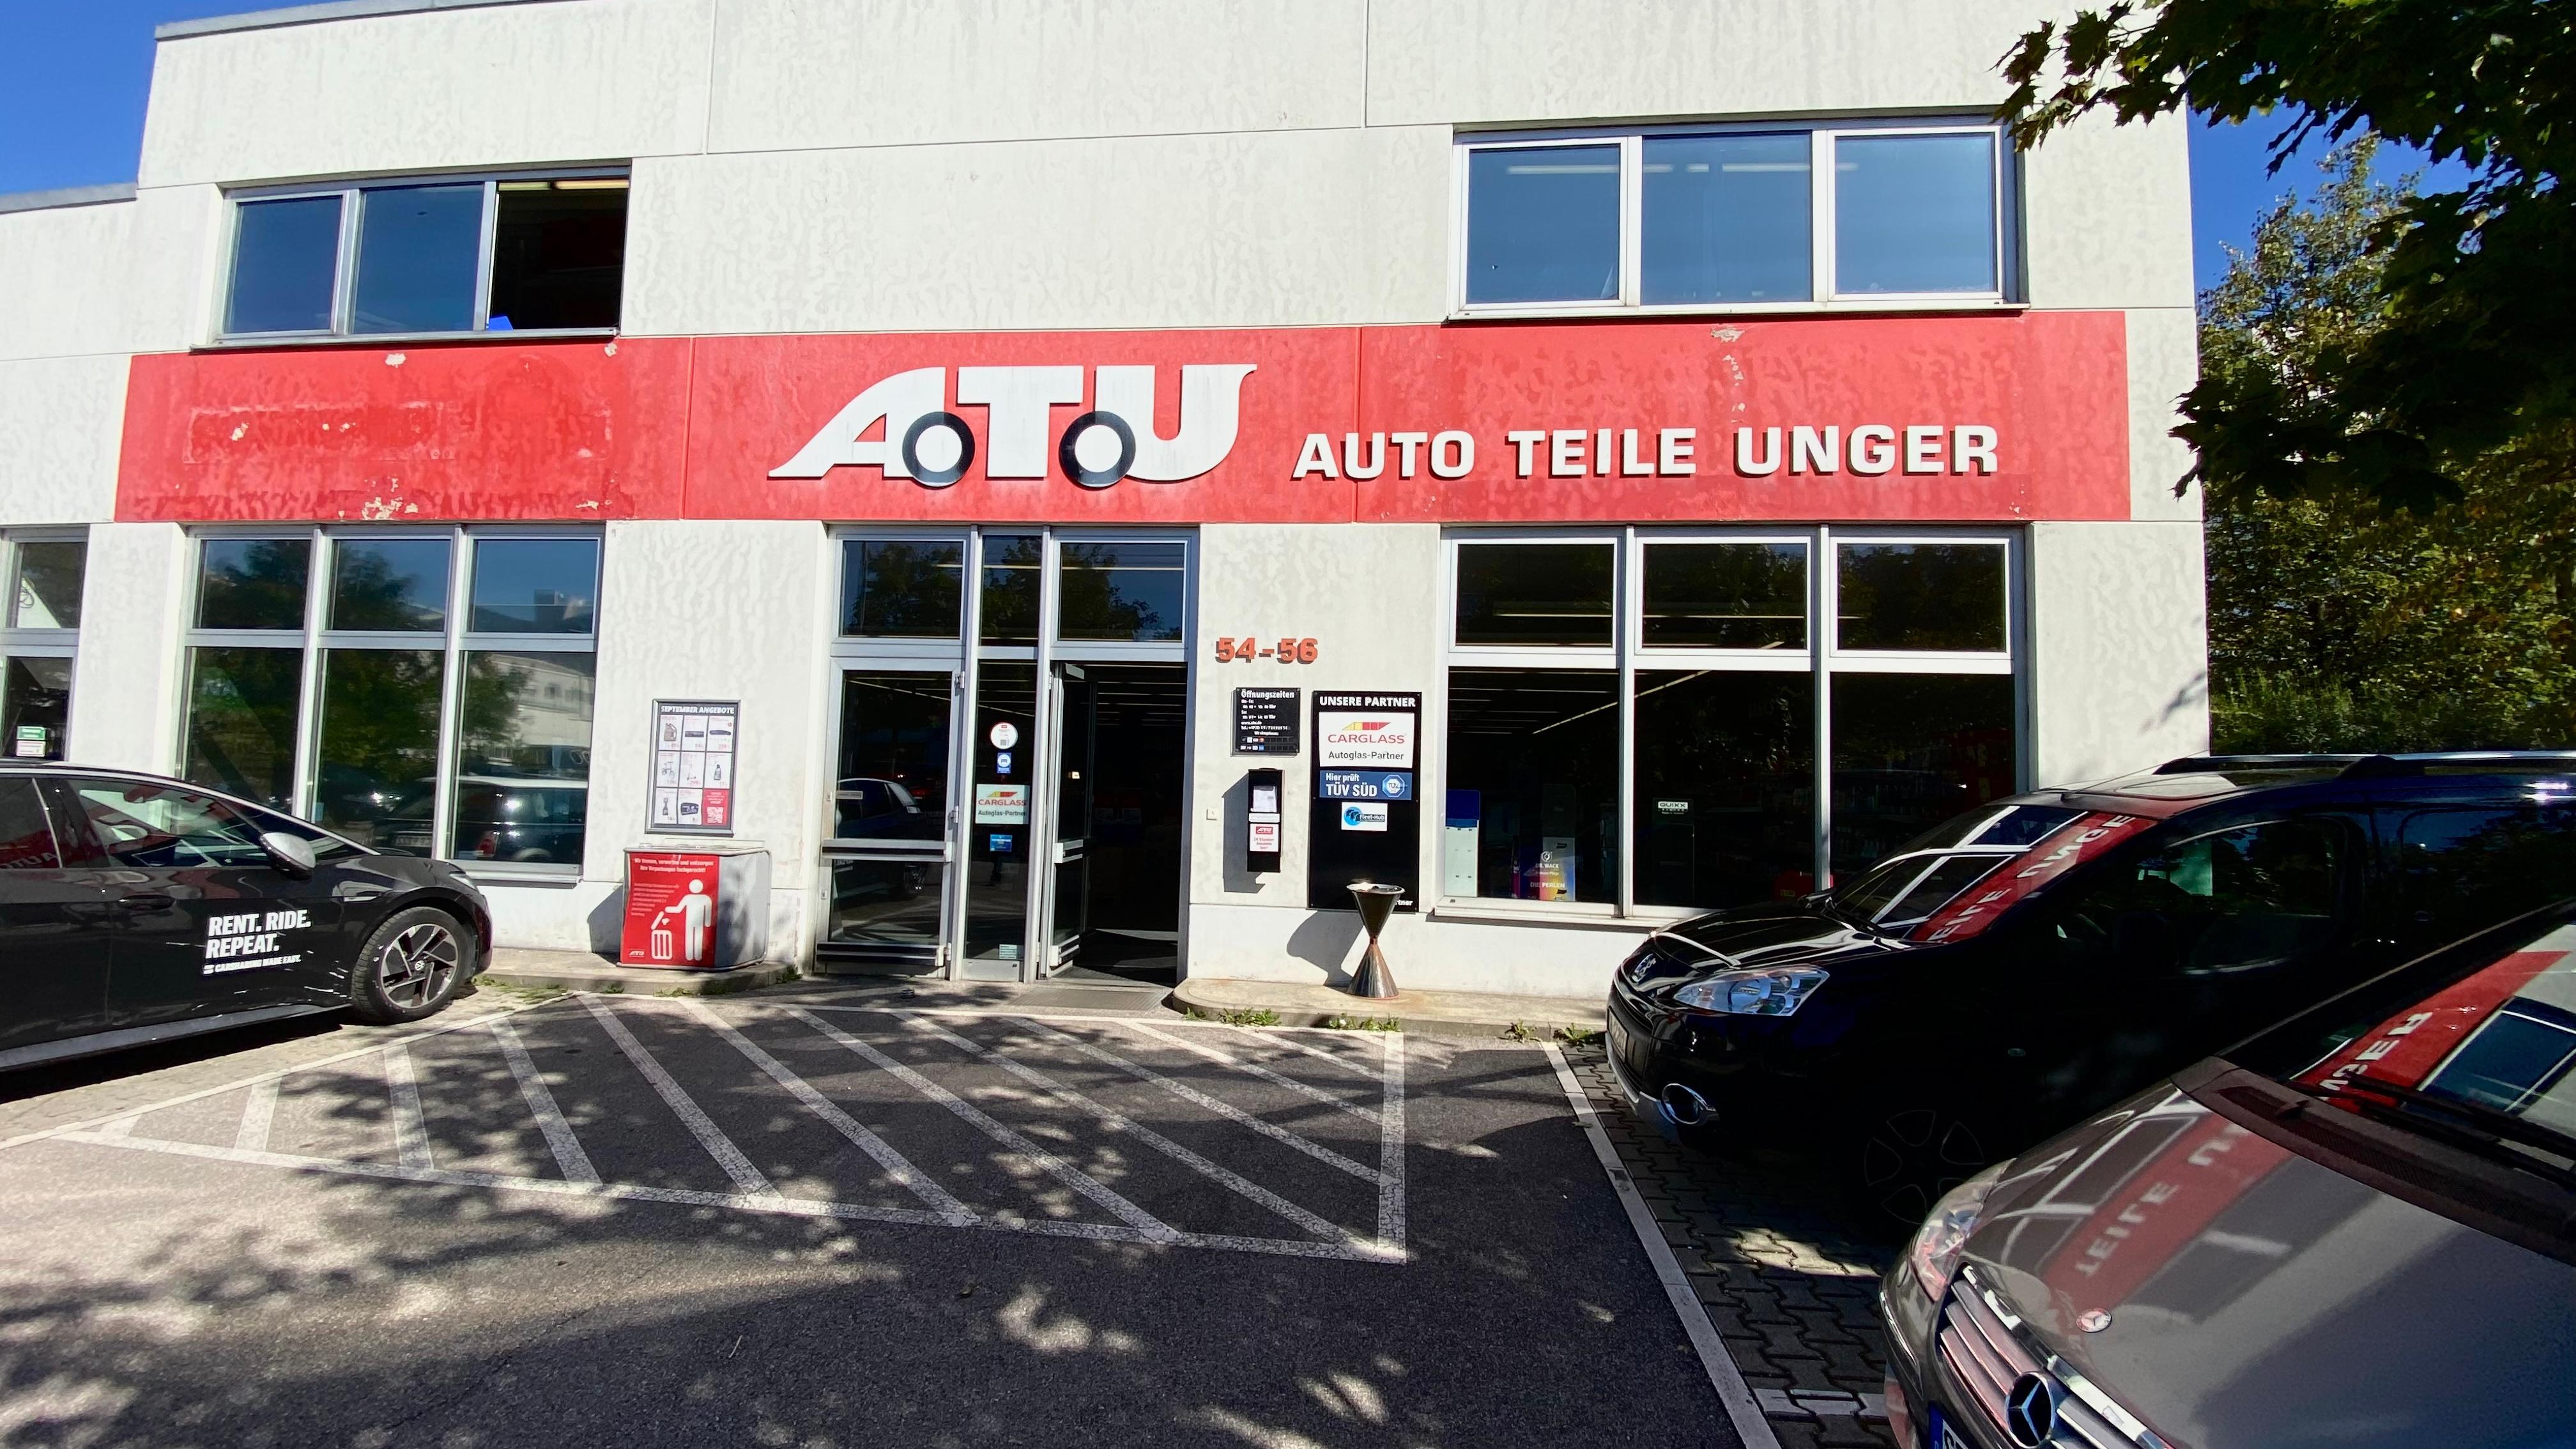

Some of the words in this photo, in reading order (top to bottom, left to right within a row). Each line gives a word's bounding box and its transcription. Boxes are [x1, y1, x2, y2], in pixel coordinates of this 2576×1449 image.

[1292, 431, 1475, 479] AUTO
[1508, 427, 1697, 477] TEILE
[1735, 424, 1999, 477] UNGER
[1241, 689, 1295, 700] Öffnungszeiten
[1319, 696, 1362, 707] UNSERE
[1365, 696, 1416, 707] PARTNER
[1328, 734, 1405, 744] CARGLASS
[1328, 751, 1404, 760] Autoglas-Partner
[1326, 772, 1340, 781] Hier
[1342, 774, 1360, 783] prüft
[1326, 781, 1350, 796] TÜV
[1352, 782, 1377, 797] SÜD
[208, 914, 262, 937] RENT.
[266, 909, 311, 931] RIDE.
[205, 933, 280, 959] REPEAT.
[263, 957, 283, 967] MADE
